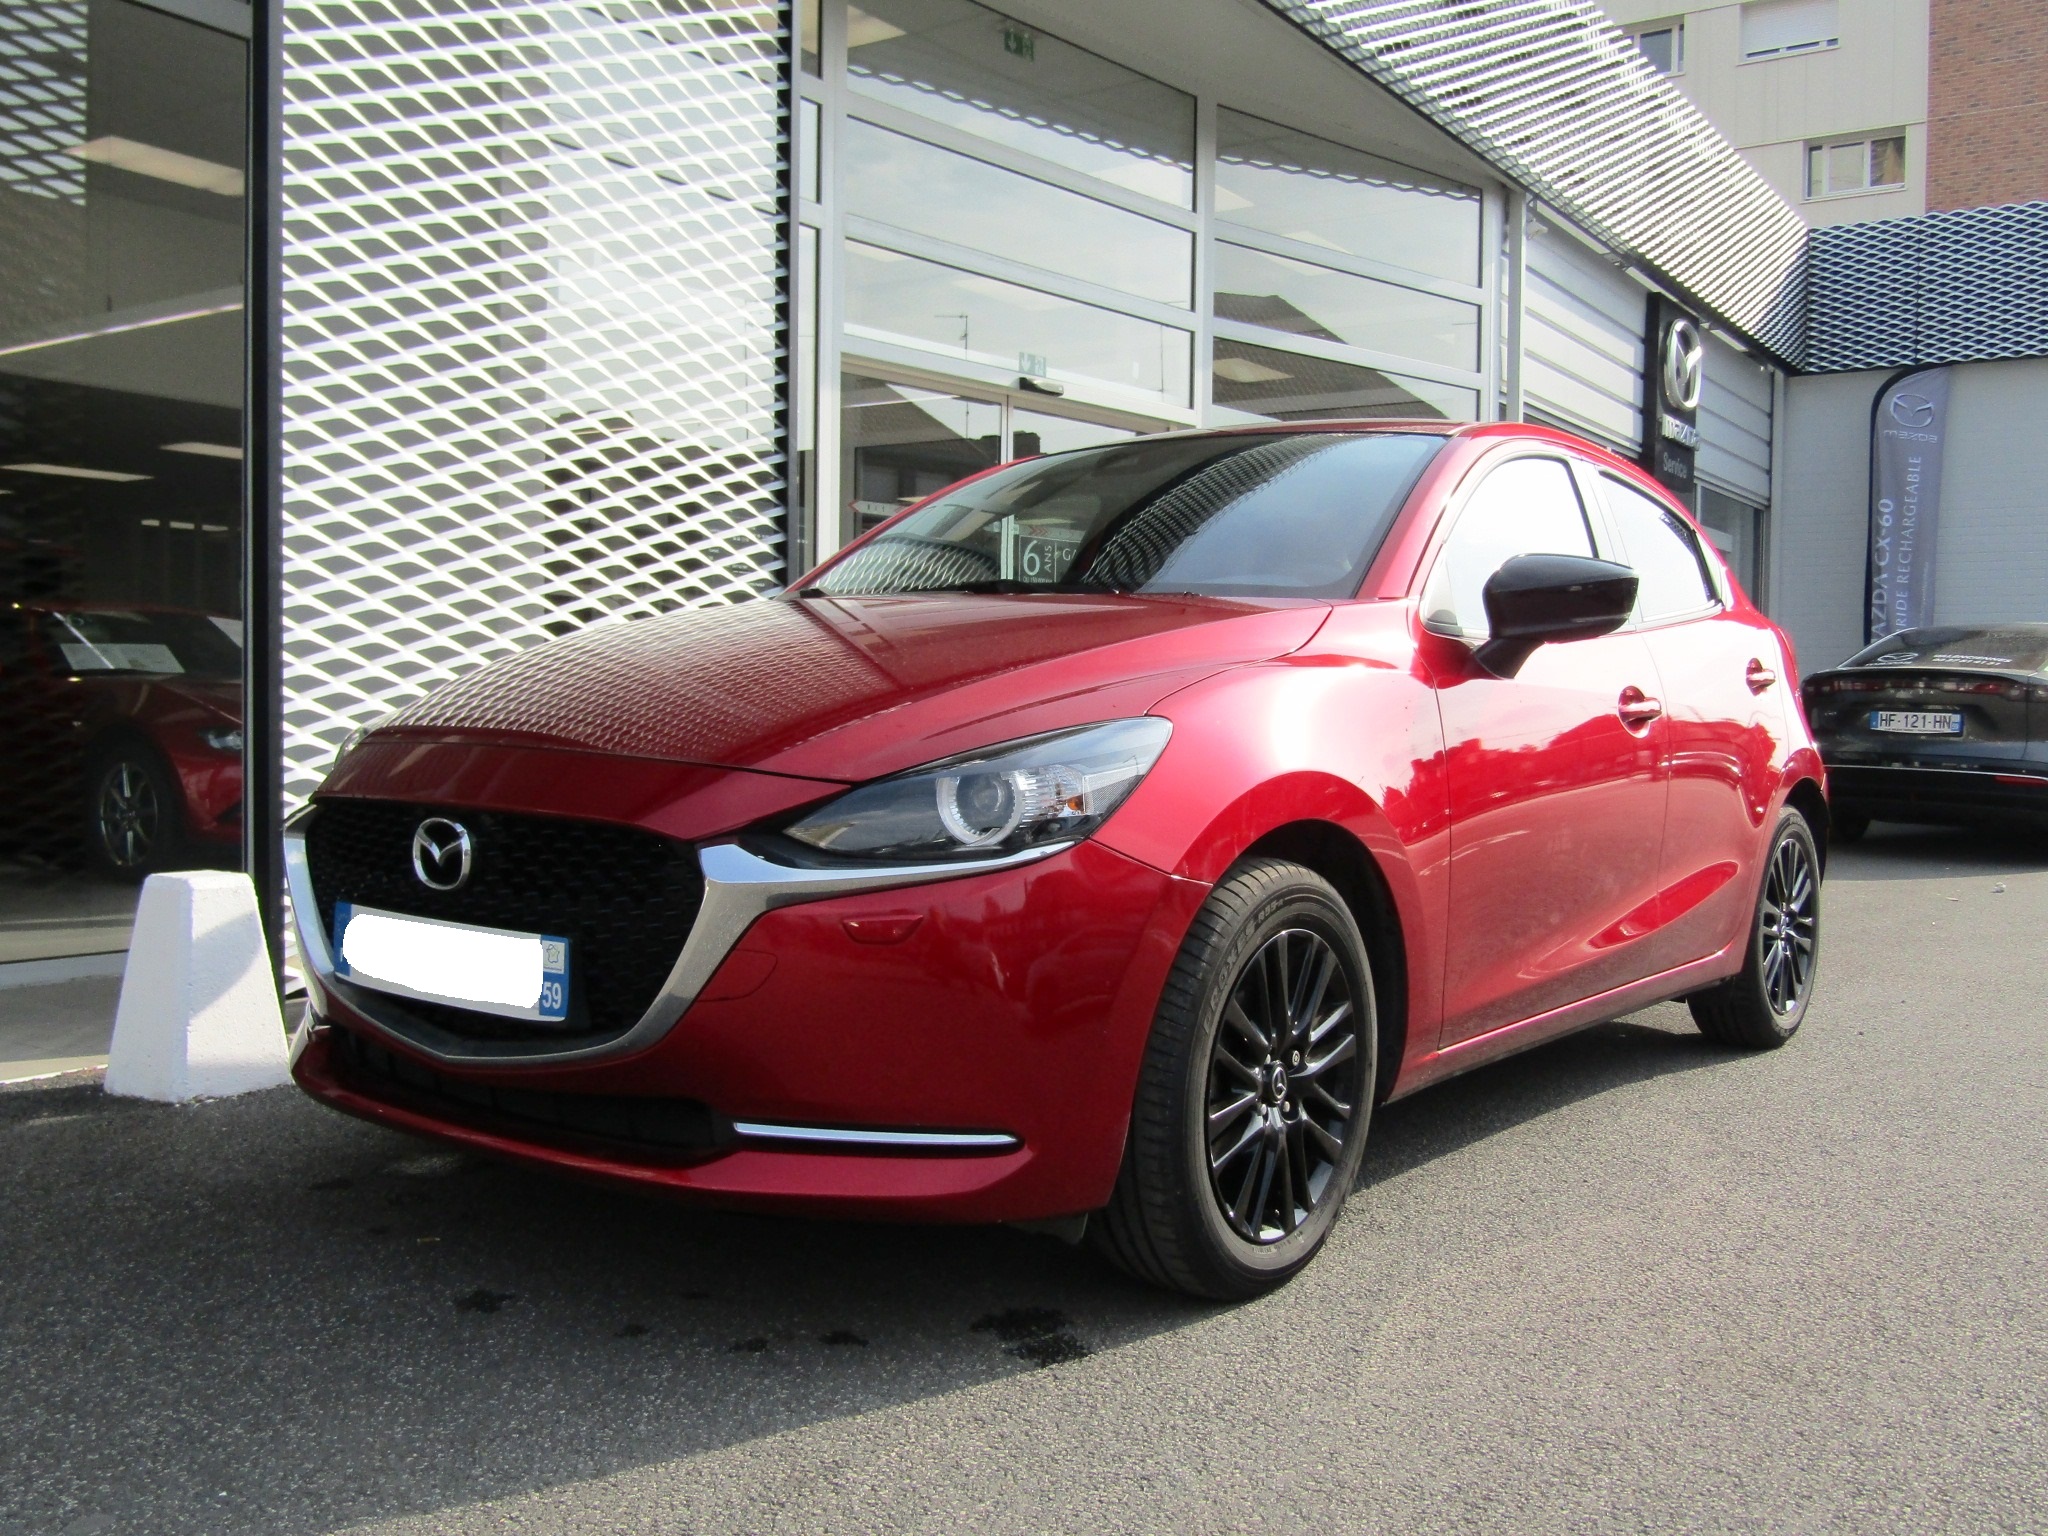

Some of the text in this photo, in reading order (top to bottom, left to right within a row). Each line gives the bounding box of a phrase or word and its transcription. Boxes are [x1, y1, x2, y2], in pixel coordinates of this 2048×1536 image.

[1663, 452, 1687, 478] Service
[1023, 540, 1040, 576] 6
[1044, 545, 1052, 573] ANS
[1895, 456, 1921, 631] RIDE RECHARGEABLE
[1871, 498, 1894, 643] AZDA CX-60
[1880, 713, 1951, 729] HF-121-HN
[542, 981, 562, 1009] 59
